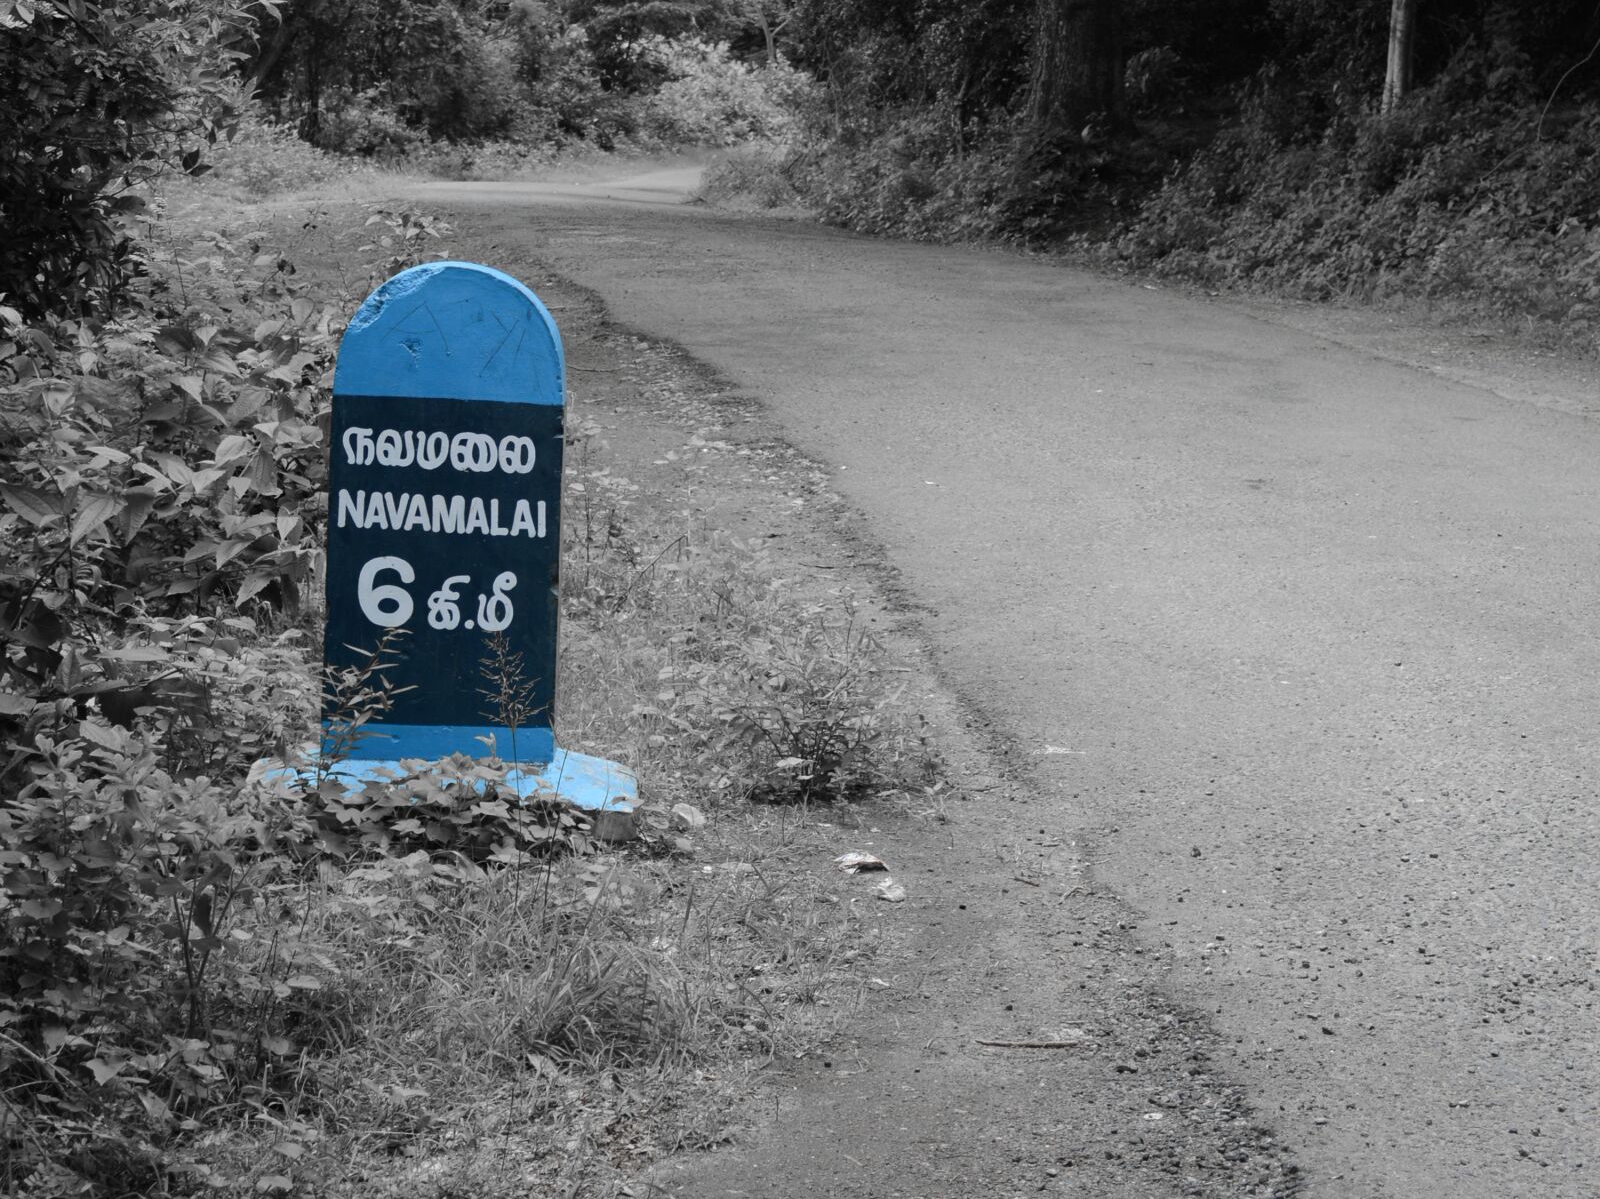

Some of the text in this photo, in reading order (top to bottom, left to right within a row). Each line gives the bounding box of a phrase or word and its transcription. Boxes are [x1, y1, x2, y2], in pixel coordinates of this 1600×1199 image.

[343, 427, 536, 474] நவமலை
[337, 489, 547, 538] NAVAMALAI
[358, 556, 518, 632] 6 கி.மீ
